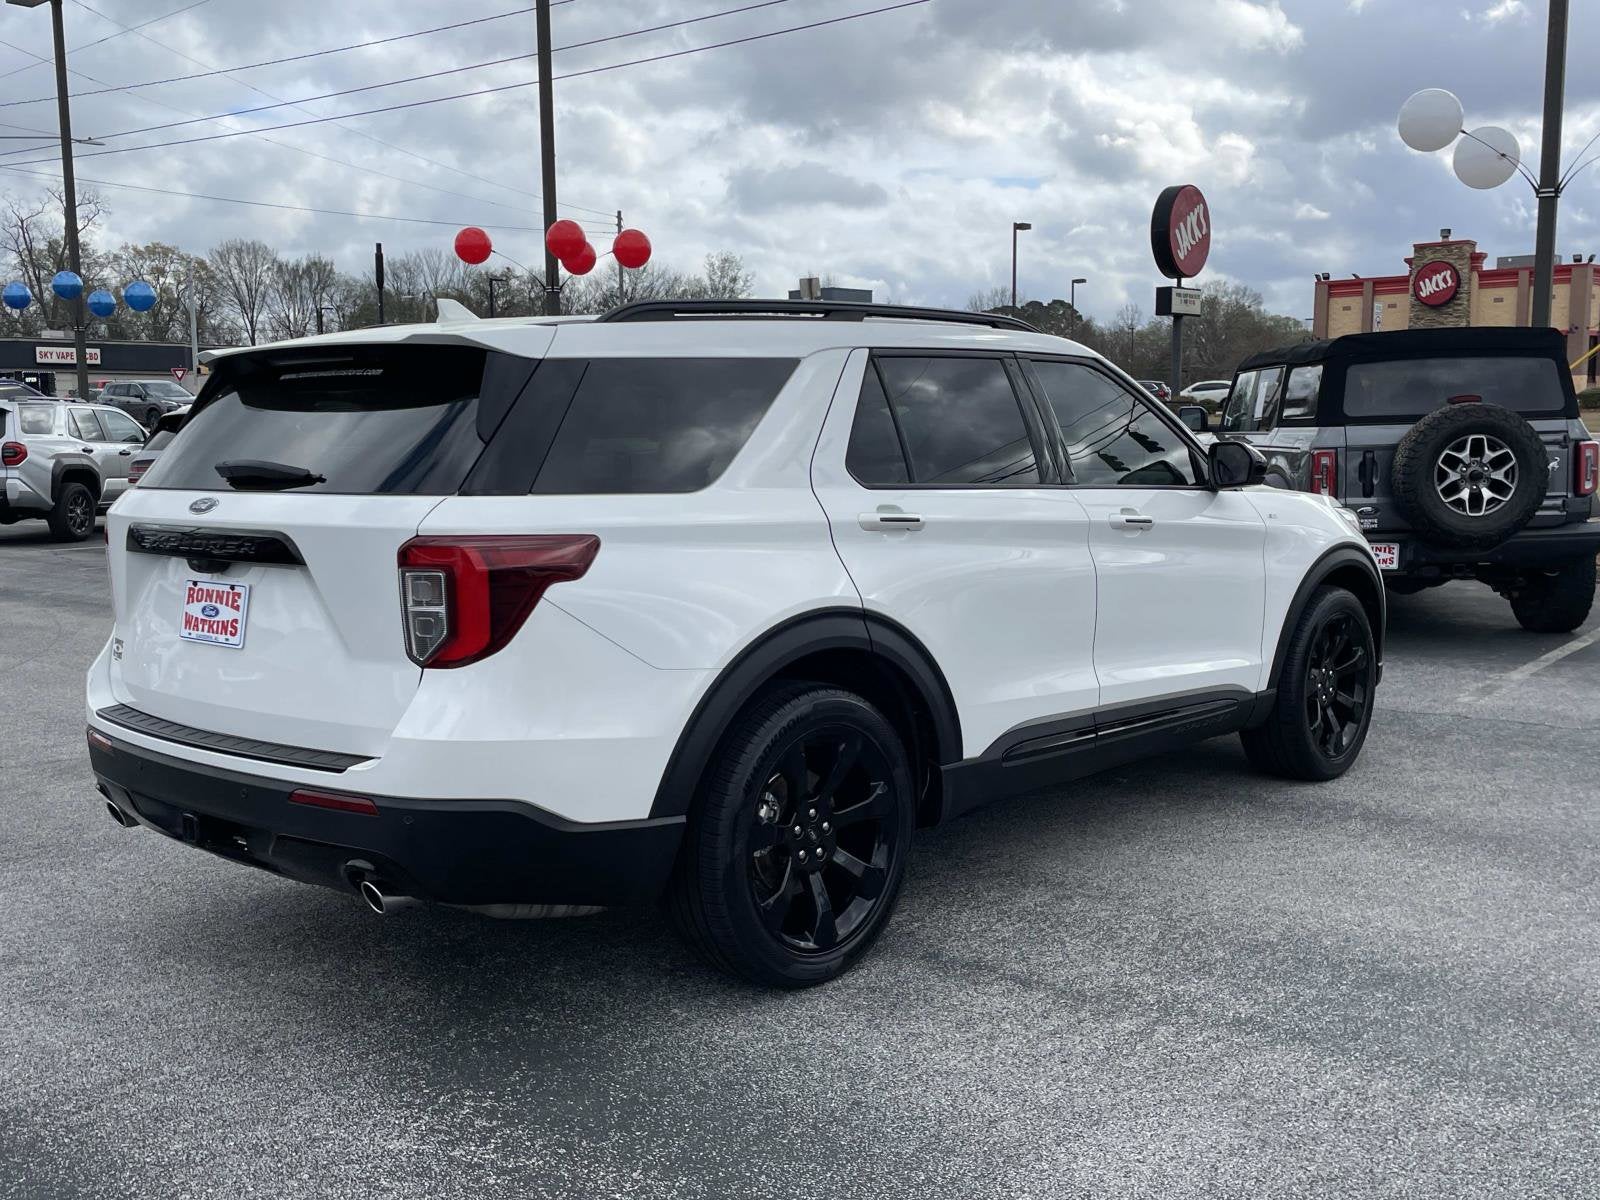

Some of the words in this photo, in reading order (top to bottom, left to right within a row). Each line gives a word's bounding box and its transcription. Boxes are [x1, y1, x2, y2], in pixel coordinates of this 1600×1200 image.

[1175, 203, 1207, 260] JACK'S
[1419, 270, 1452, 297] JACK'S
[39, 351, 53, 360] SKY
[56, 350, 75, 360] VAPE
[85, 352, 98, 361] CBD
[186, 586, 242, 612] RONNIE
[184, 611, 239, 637] WATKINS
